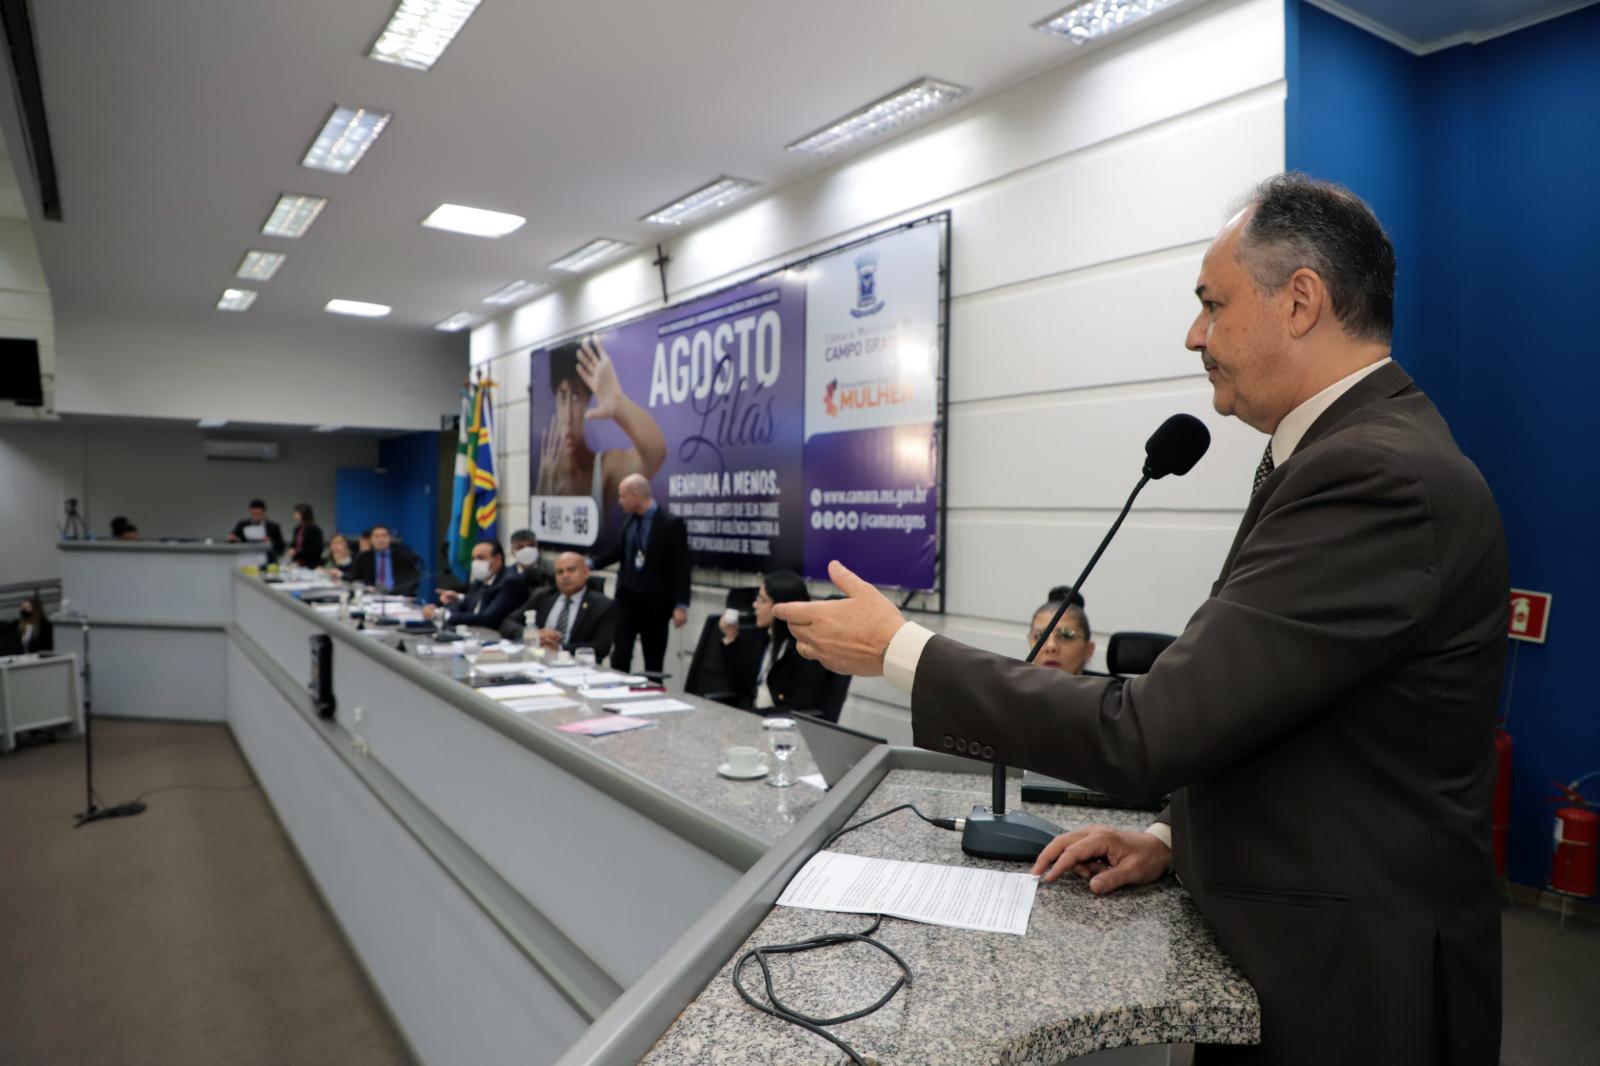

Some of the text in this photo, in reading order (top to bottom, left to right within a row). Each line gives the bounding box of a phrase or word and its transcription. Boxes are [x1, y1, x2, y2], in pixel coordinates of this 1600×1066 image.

[649, 310, 781, 408] AGOSTO
[825, 340, 863, 362] CAMPO
[668, 470, 781, 497] NENHUMA A MENOS.
[823, 484, 927, 508] www.camara.ms.gov.br
